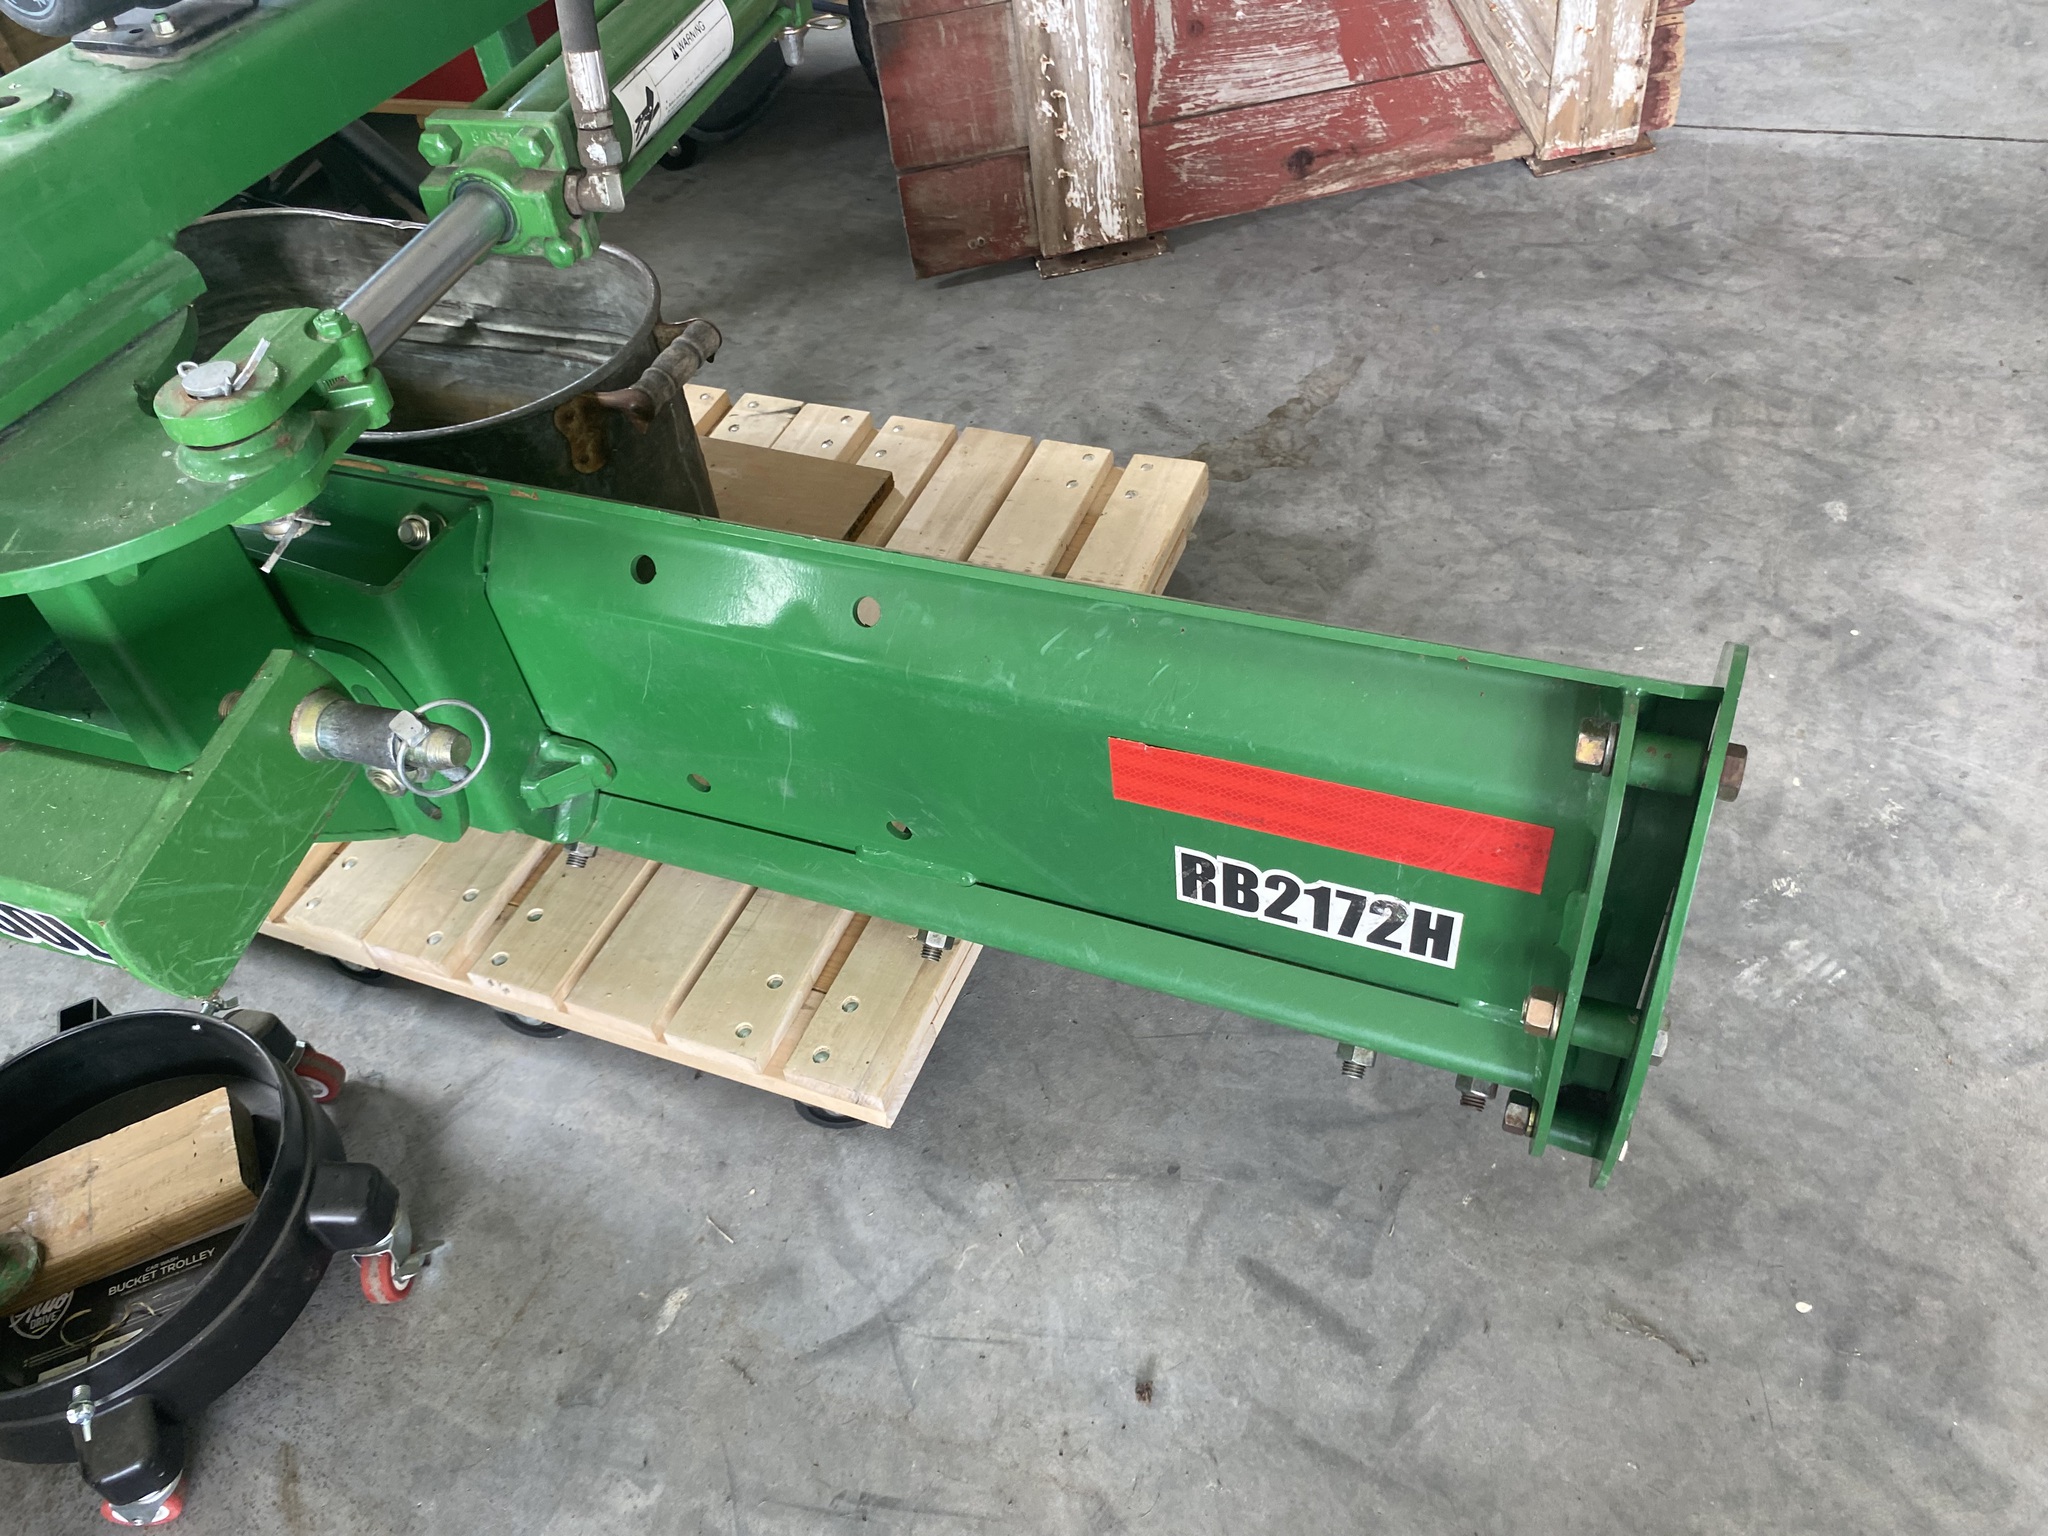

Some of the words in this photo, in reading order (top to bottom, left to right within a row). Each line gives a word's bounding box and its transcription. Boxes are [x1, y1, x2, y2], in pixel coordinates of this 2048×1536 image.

[676, 20, 706, 53] WARNING
[1181, 852, 1455, 962] RB2172H
[108, 1270, 158, 1296] BUCKET
[160, 1247, 216, 1275] TROLLEY
[145, 1263, 159, 1273] CAR
[30, 1312, 58, 1330] DRIVE
